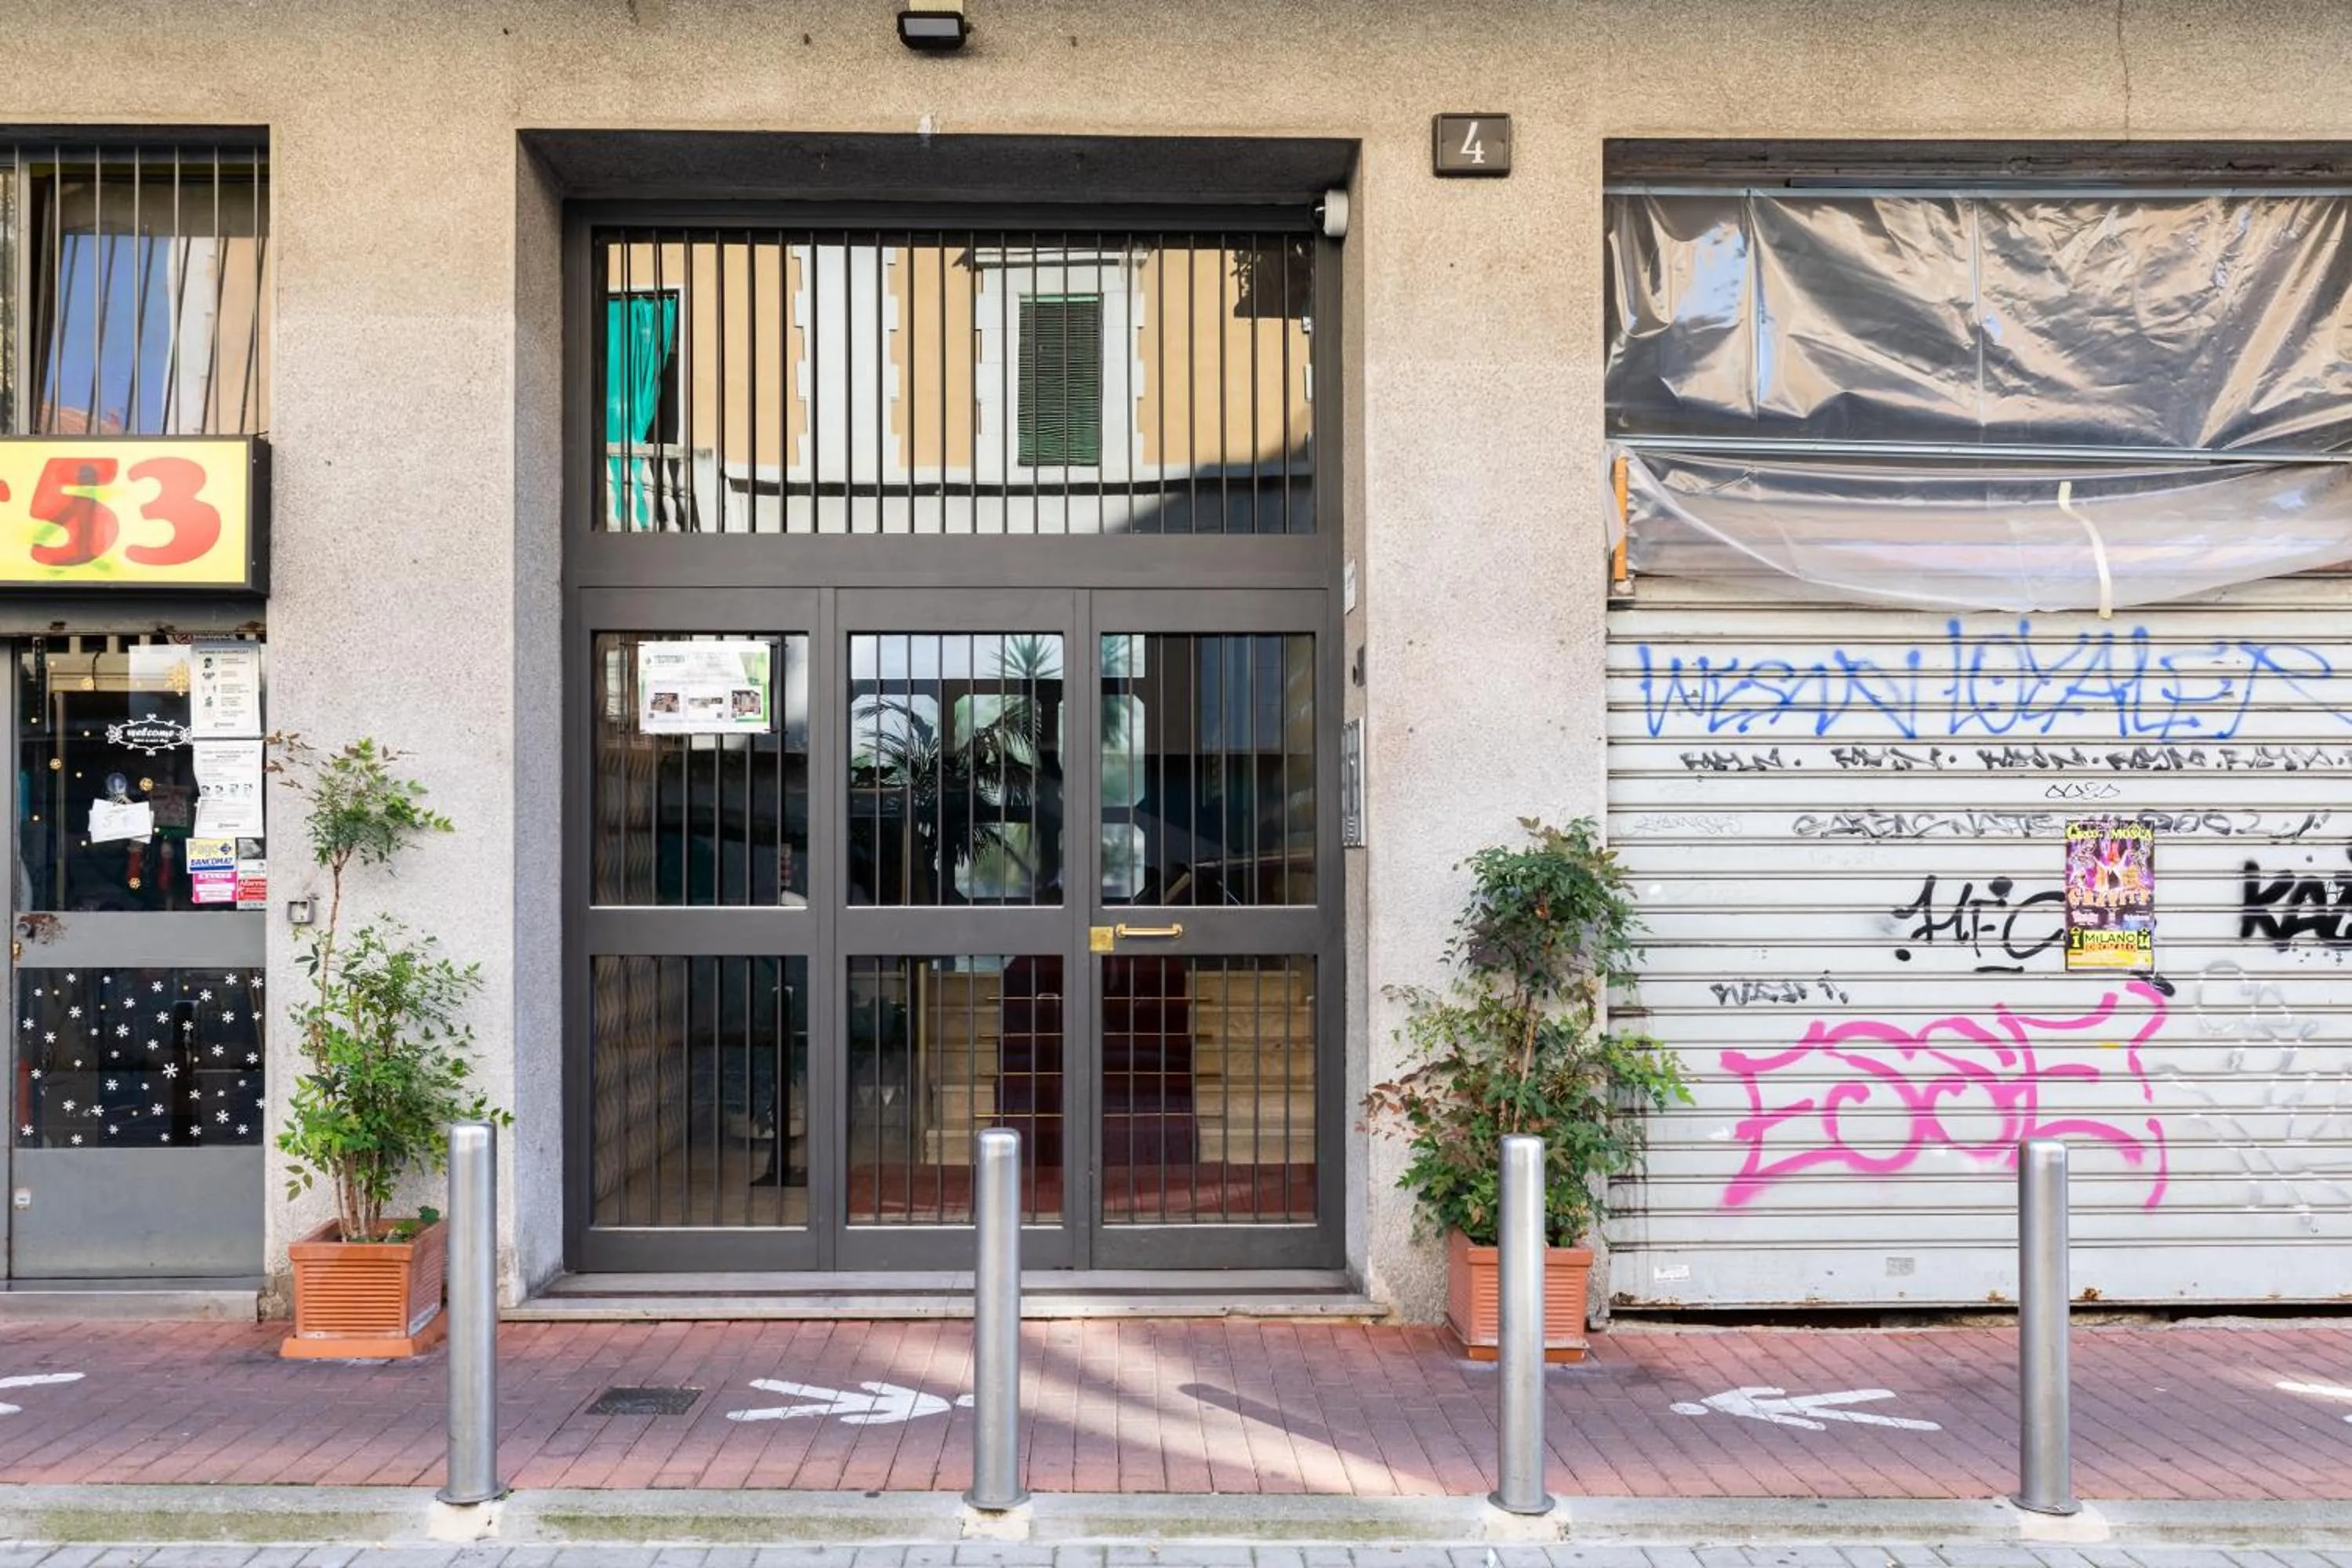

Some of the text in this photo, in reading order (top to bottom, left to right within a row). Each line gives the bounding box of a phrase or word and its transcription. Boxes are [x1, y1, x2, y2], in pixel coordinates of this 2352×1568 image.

[1460, 122, 1486, 164] 4
[30, 457, 222, 566] 53
[191, 857, 233, 866] BANCOMAT
[2085, 933, 2136, 943] MILANO
